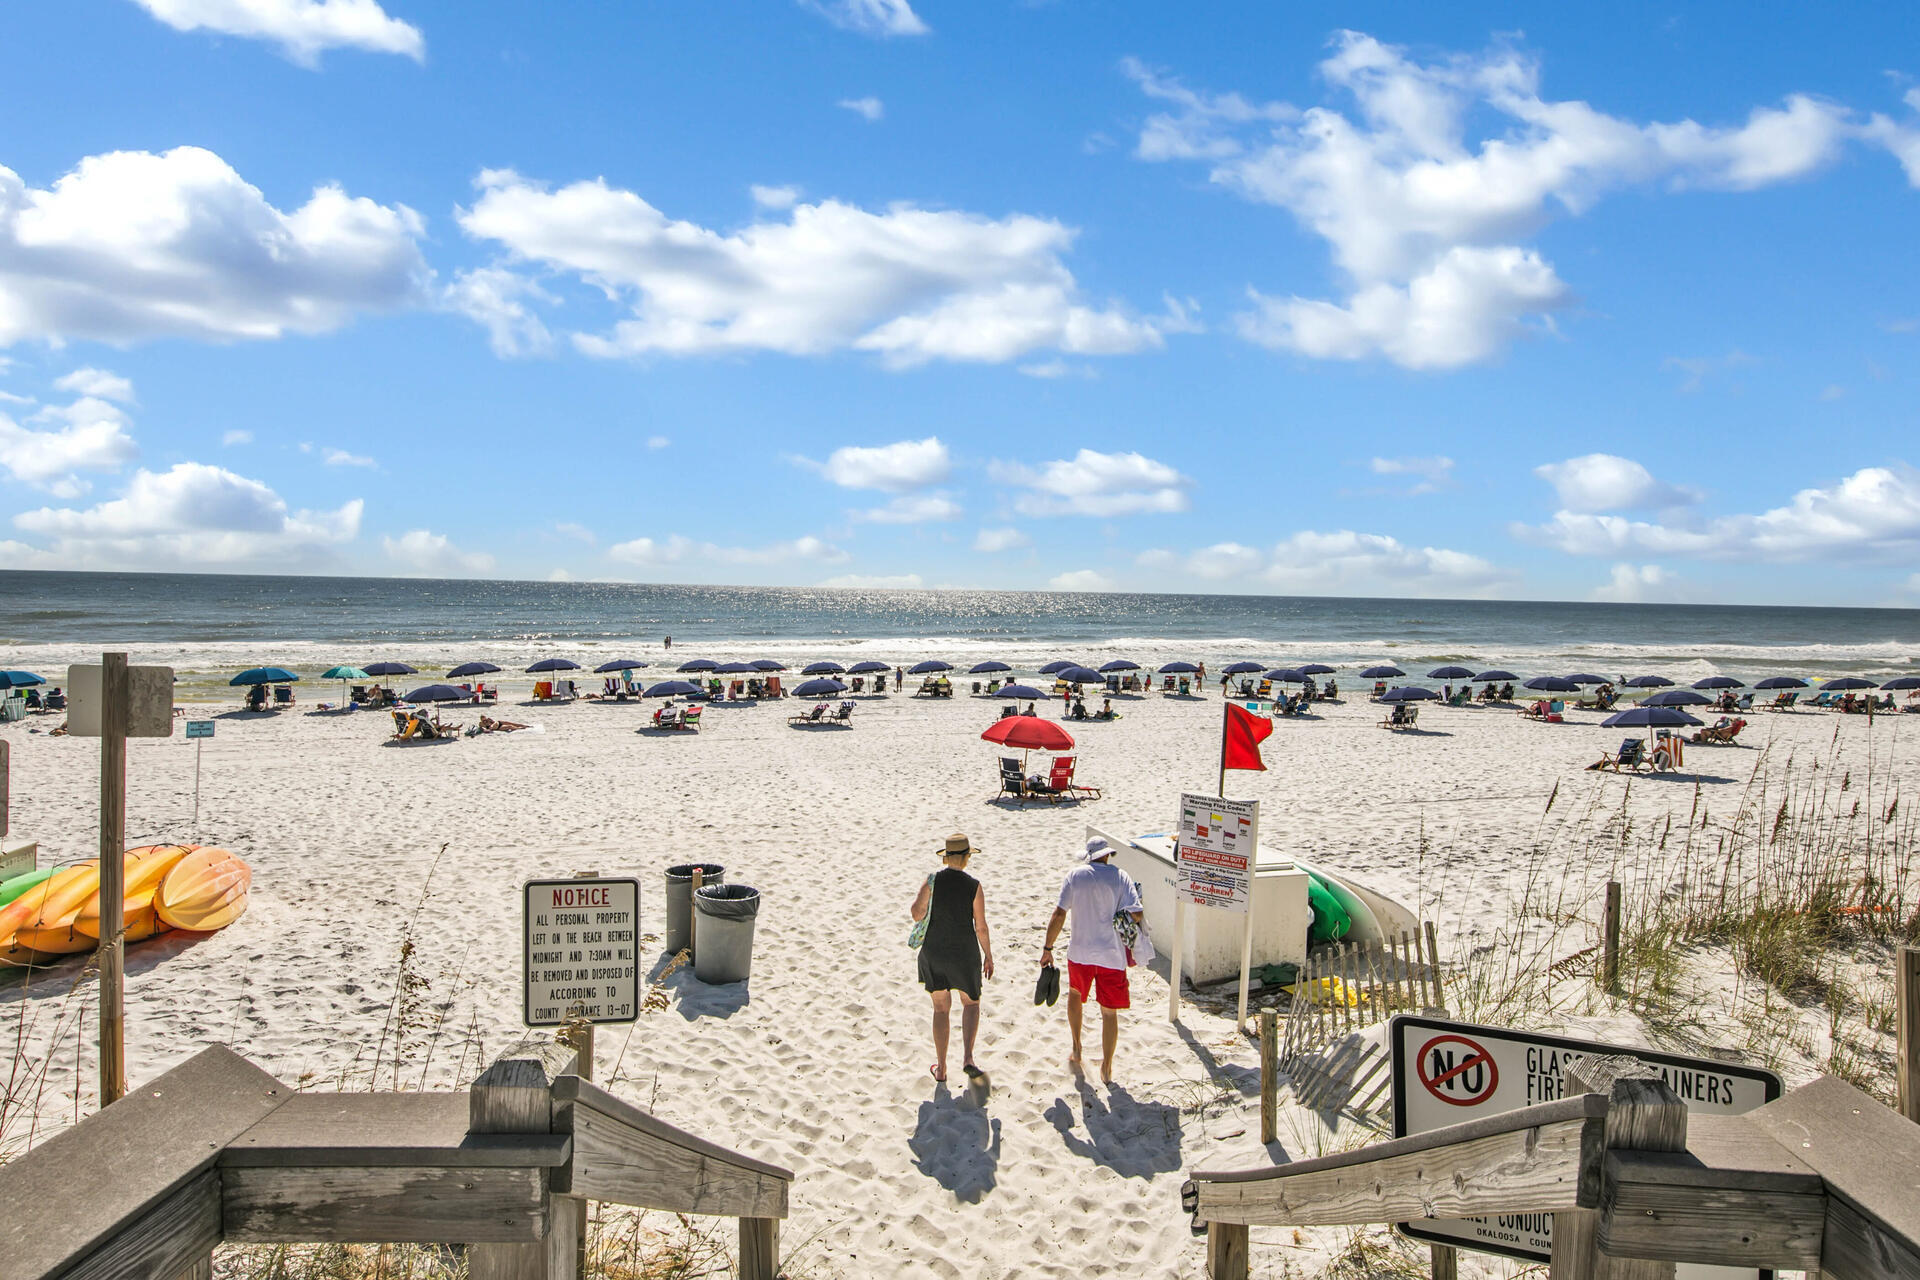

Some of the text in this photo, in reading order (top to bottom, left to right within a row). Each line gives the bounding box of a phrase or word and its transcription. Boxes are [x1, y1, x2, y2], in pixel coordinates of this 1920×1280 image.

[1189, 799, 1212, 807] Warning
[1214, 802, 1226, 810] Flag
[1192, 850, 1220, 859] LIFEGUARD
[552, 888, 610, 906] NOTICE
[1202, 884, 1234, 899] CURRENT
[1194, 897, 1206, 905] NO
[536, 912, 629, 926] ALL PERSONAL PROPERTY
[532, 930, 633, 945] LEFT ON THE BEACH BETWEEN
[532, 949, 633, 964] MIDNIGHT AND 7:30AM WILL
[531, 967, 634, 982] BE REMOVED AND DISPOSED OF
[550, 986, 616, 1000] ACCORDING TO
[535, 1007, 559, 1019] COUNTY
[607, 1004, 630, 1016] 13-07
[1433, 1048, 1483, 1094] NO
[1649, 1065, 1733, 1105] AINERS
[1477, 1228, 1520, 1243] OKALOOSA
